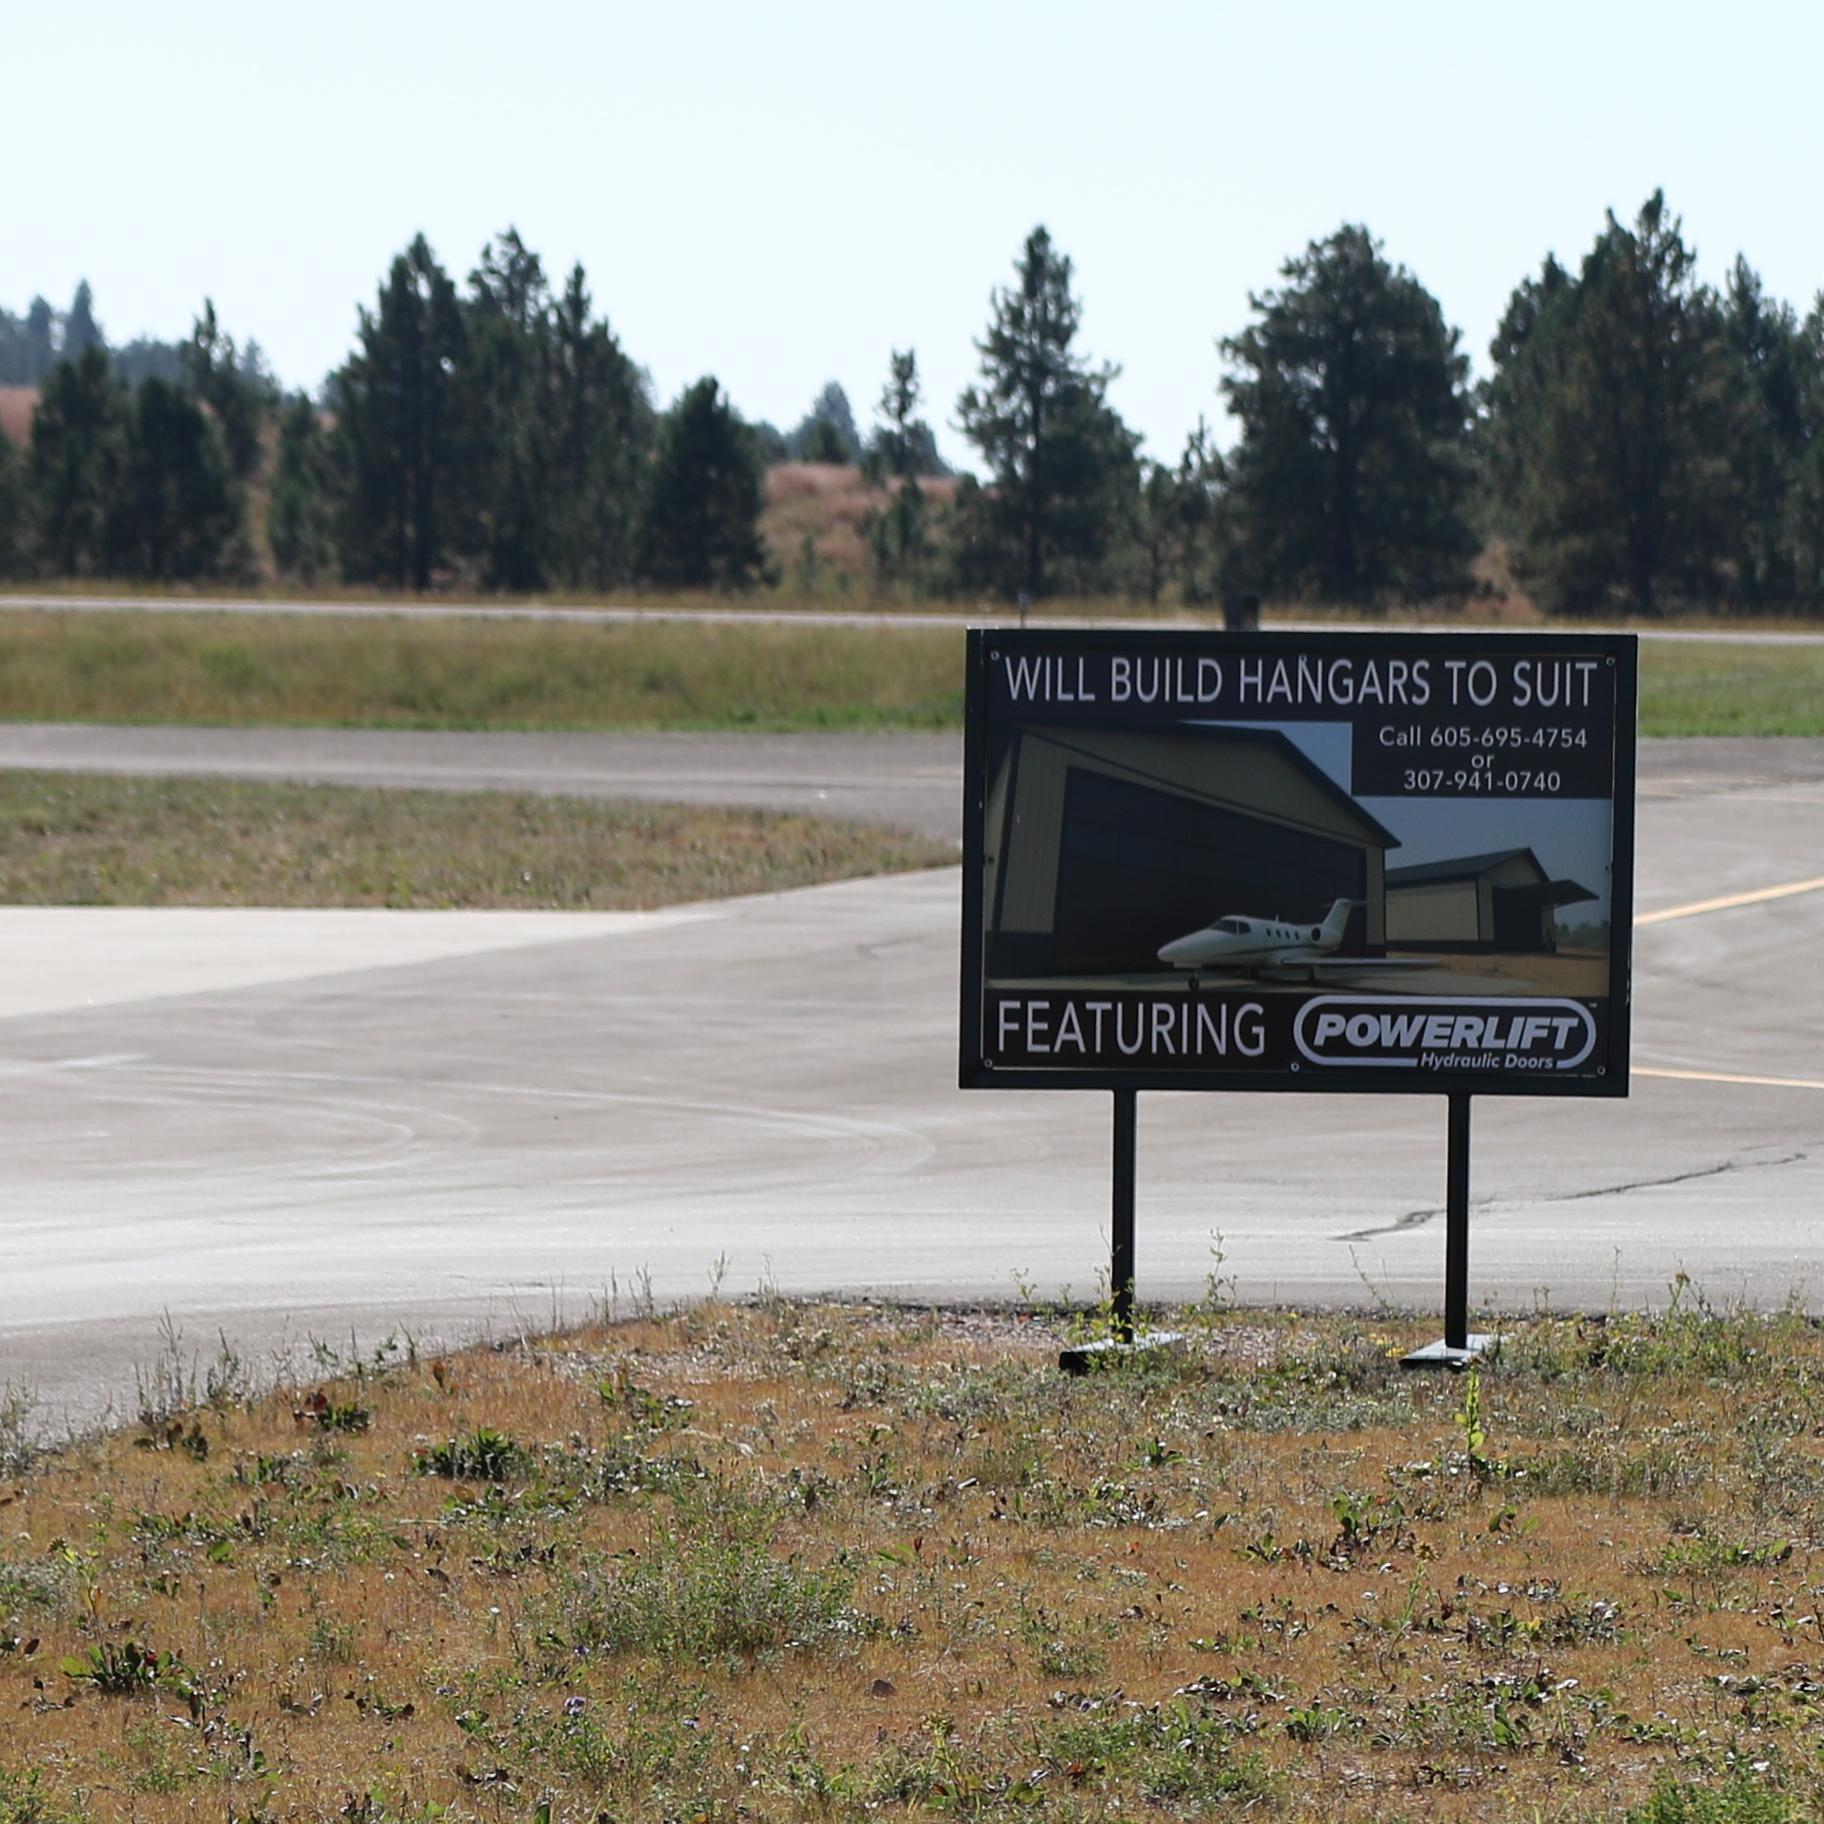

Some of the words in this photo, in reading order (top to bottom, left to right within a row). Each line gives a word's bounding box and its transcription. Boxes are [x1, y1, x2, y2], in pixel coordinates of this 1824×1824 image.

[1005, 656, 1095, 701] WILL
[1111, 657, 1223, 703] BUILD
[1240, 658, 1430, 705] HANGARS
[1444, 660, 1497, 706] TO
[1513, 661, 1597, 707] SUIT
[1379, 726, 1421, 746] Call
[1430, 727, 1587, 748] 605-695-4754
[1471, 754, 1494, 769] or
[1403, 769, 1561, 791] 307-941-0740
[998, 1001, 1265, 1056] FEATURING
[1313, 1014, 1579, 1049] POWERLIFT
[1420, 1052, 1500, 1071] Hydraulic
[1504, 1053, 1554, 1069] Doors
